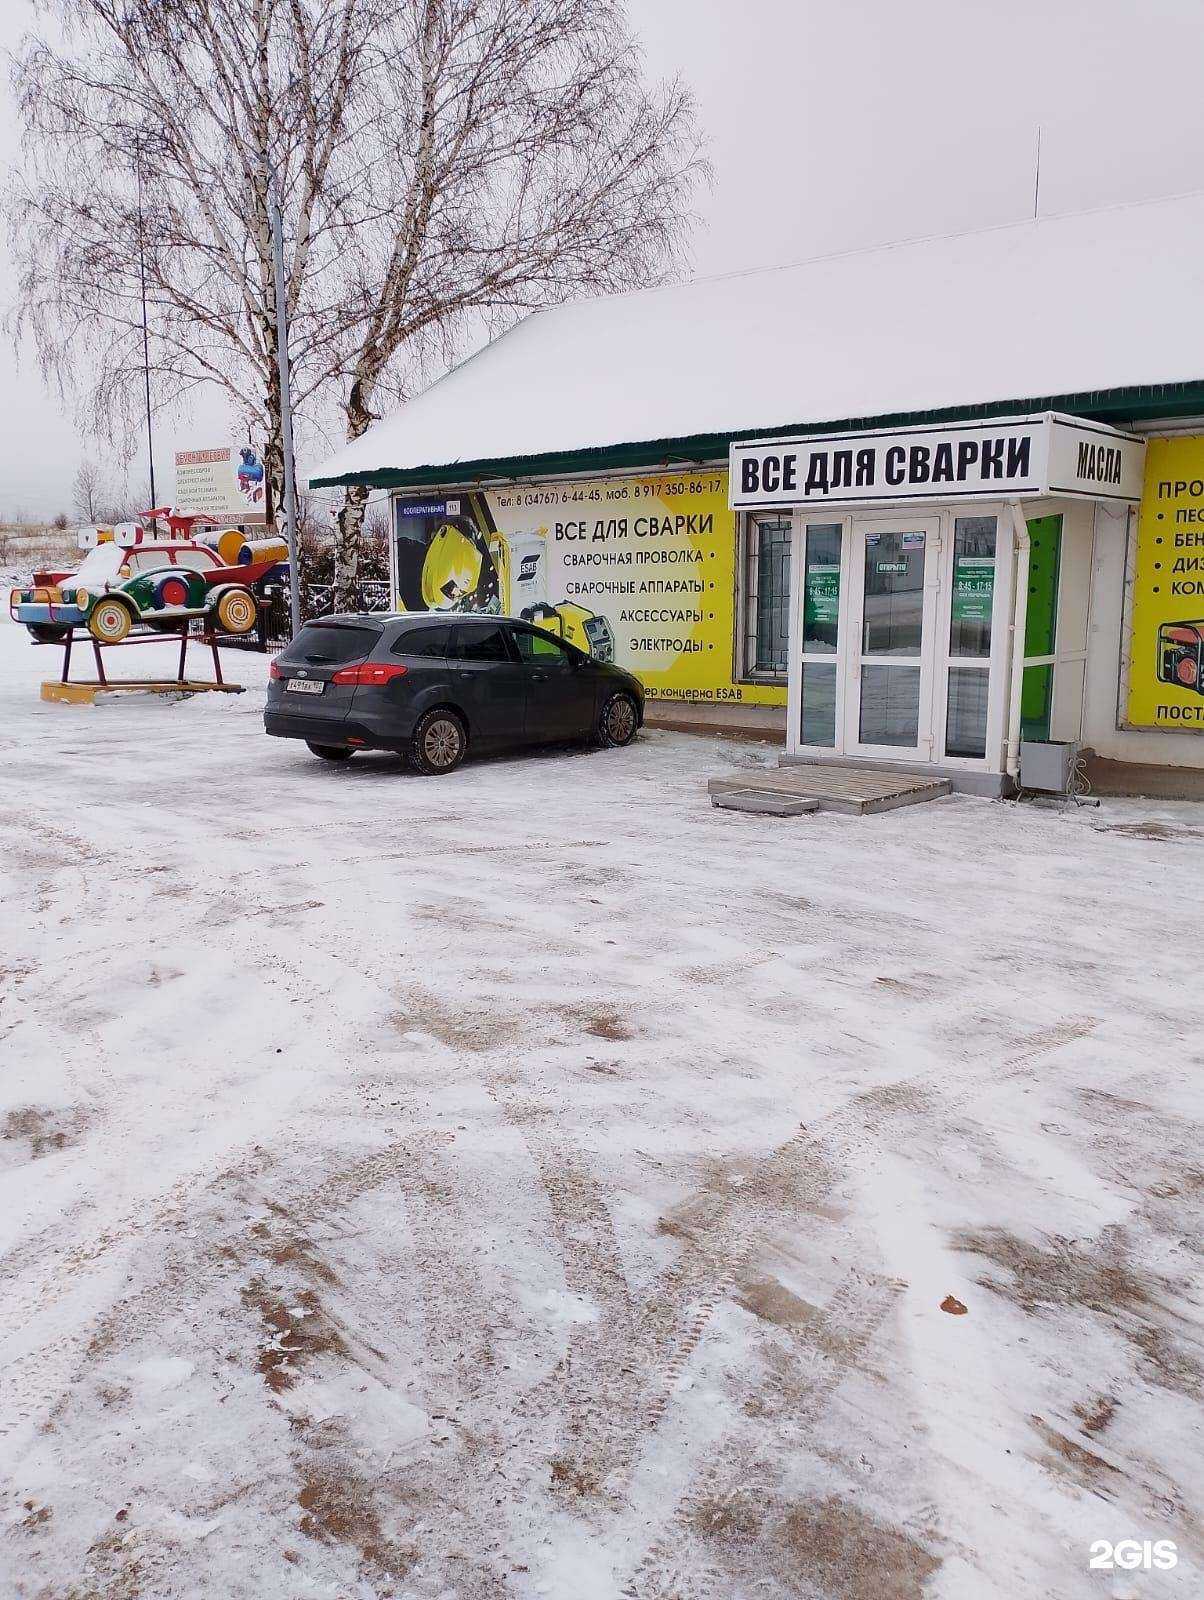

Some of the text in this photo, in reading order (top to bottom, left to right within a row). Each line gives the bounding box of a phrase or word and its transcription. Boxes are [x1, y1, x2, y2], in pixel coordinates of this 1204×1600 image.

[741, 436, 1031, 495] ВСЕ ДЛЯ СВАРКИ
[1077, 441, 1122, 485] МАСЛА
[497, 480, 725, 507] Тел: 8 (34767) 6-44-45, моб. 8 917 350-86-17,
[555, 513, 714, 543] ВСЕ ДЛЯ СВАРКИ
[563, 549, 704, 566] СВАРОЧНАЯ ПРОВОЛКА
[520, 562, 537, 574] ESAB
[566, 579, 705, 594] СВАРОЧНЫЕ АППАРАТЫ
[620, 609, 703, 623] АКСЕССУАРЫ
[630, 638, 703, 653] ЭЛЕКТРОДЫ
[660, 688, 713, 700] концерна
[716, 688, 742, 700] ESAB
